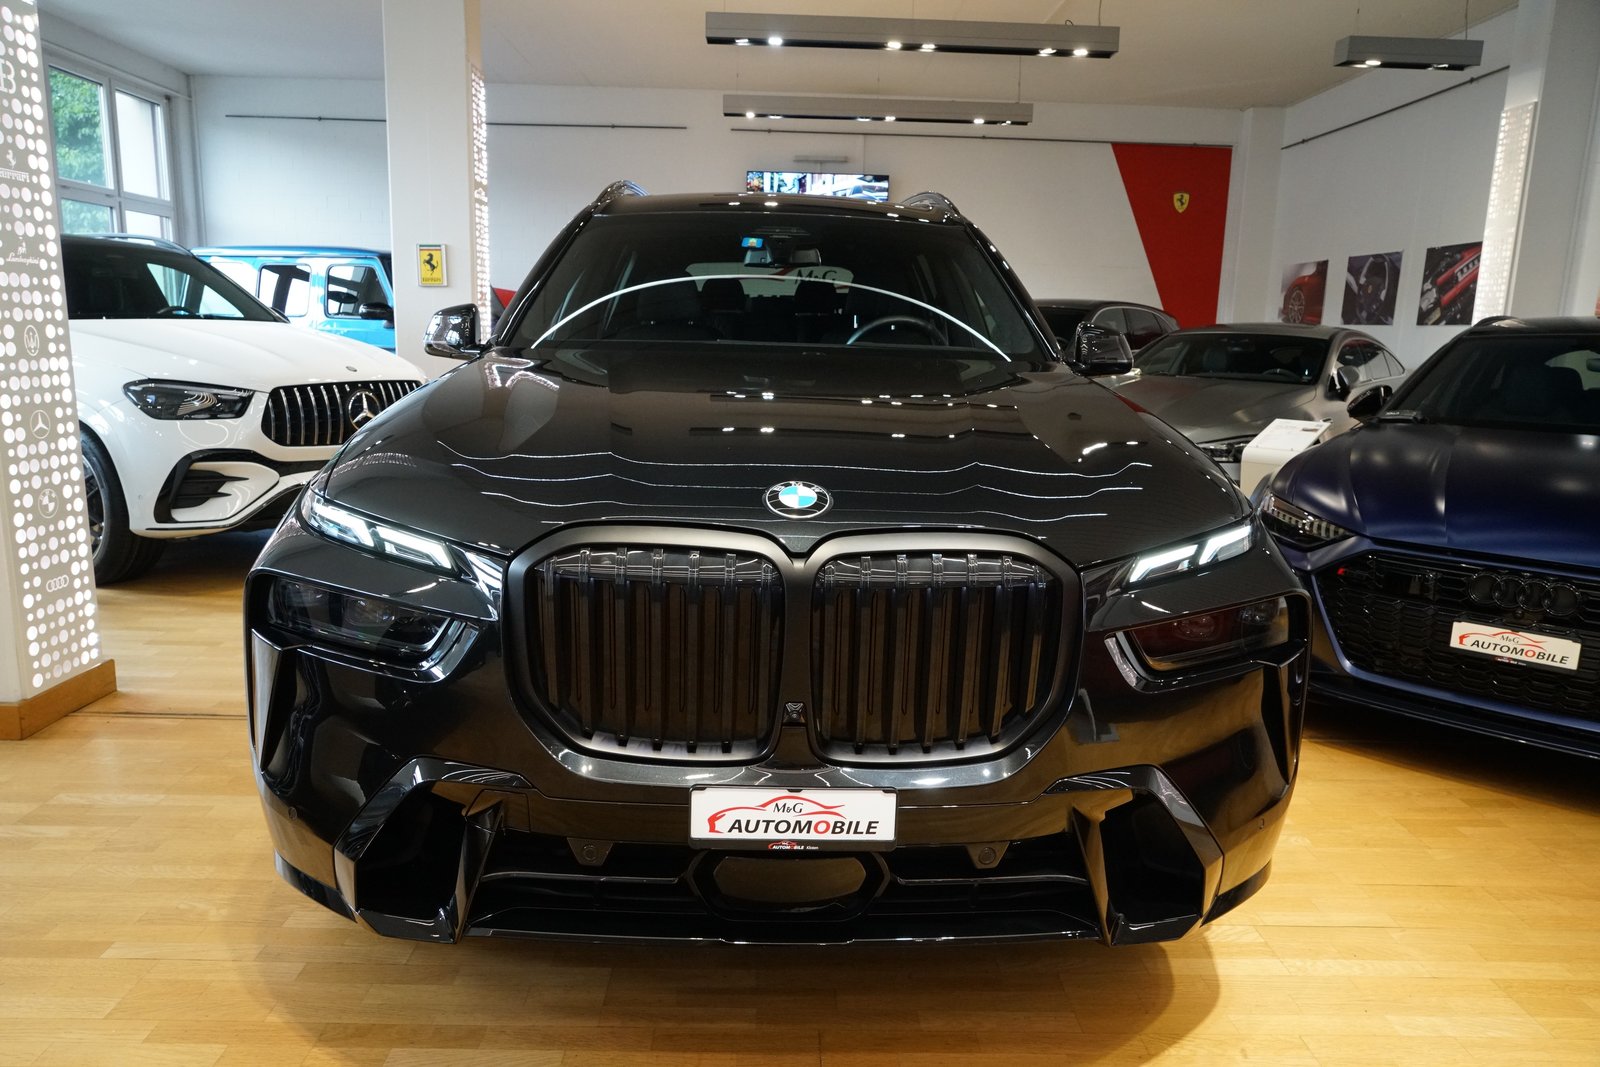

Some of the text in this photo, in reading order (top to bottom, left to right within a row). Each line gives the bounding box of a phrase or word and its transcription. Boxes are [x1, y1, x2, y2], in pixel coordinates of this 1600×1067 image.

[0, 169, 30, 183] errari
[1471, 640, 1569, 664] AUTOMOBILE
[773, 802, 804, 814] M&G
[728, 820, 879, 835] AUTOMOBILE
